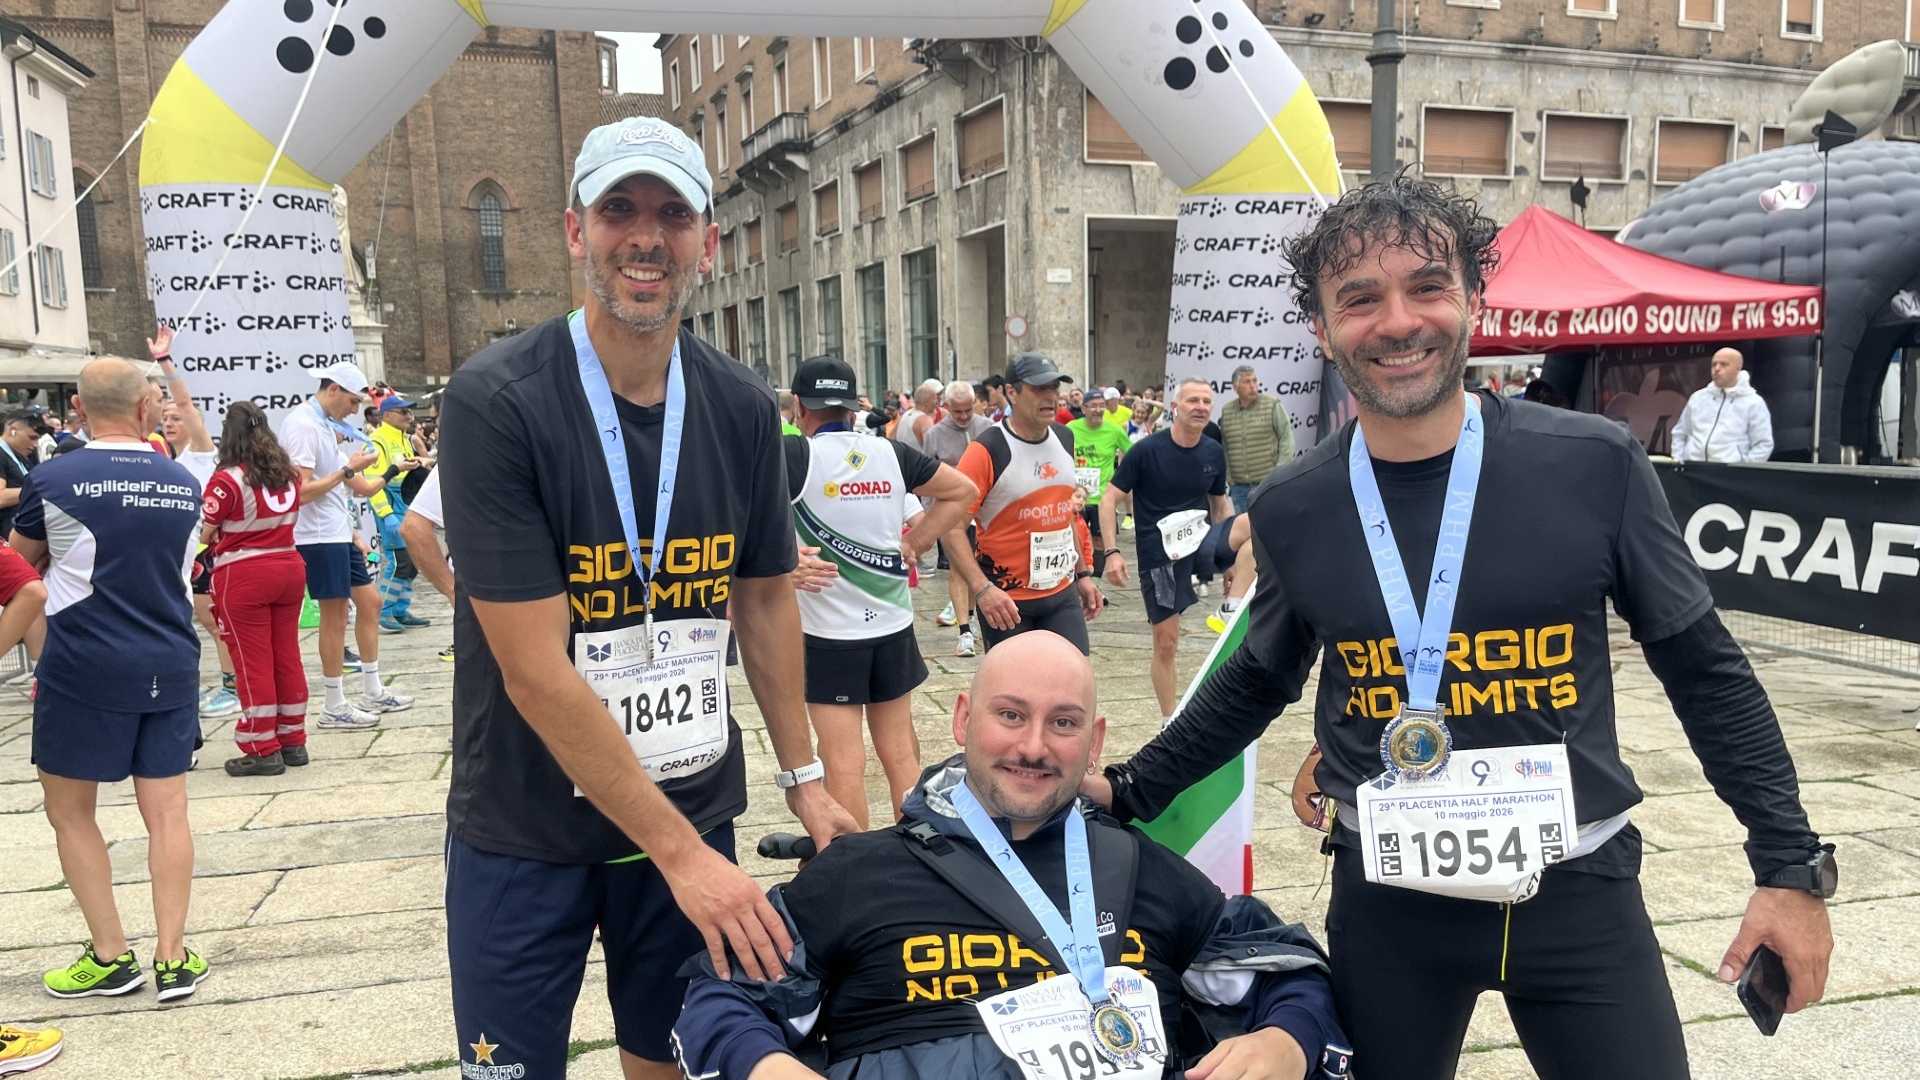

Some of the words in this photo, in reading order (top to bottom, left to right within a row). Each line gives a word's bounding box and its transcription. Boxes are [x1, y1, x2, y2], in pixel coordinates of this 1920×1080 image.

[158, 192, 235, 209] CRAFT
[273, 194, 330, 213] CRAFT
[1235, 200, 1307, 214] CRAFT
[224, 233, 308, 249] CRAFT
[1194, 237, 1260, 251] CRAFT
[170, 275, 248, 291] CRAFT
[286, 275, 343, 291] CRAFT
[237, 315, 320, 330] CRAFT
[1188, 309, 1253, 323] CRAFT
[1509, 309, 1560, 337] 94.6
[1568, 304, 1638, 335] RADIO
[1645, 304, 1722, 334] SOUND
[1731, 301, 1766, 331] FM
[1771, 297, 1819, 328] 95.0
[1223, 345, 1293, 360] CRAFT
[183, 356, 261, 372] CRAFT
[1276, 381, 1320, 395] CRAFT
[840, 481, 892, 496] CONAD
[122, 495, 195, 511] Piacenza
[1018, 503, 1054, 520] SPORT
[1177, 525, 1193, 541] 816
[1684, 502, 1920, 594] CRAF
[570, 590, 616, 623] NO
[623, 575, 731, 616] LMITS
[650, 661, 669, 672] HALF
[671, 653, 714, 667] MARATHON
[669, 668, 686, 677] 2026
[1345, 686, 1401, 720] NO
[1443, 672, 1578, 717] IMITS
[620, 684, 693, 735] 1842
[660, 752, 709, 773] CRAFT
[1534, 760, 1553, 773] PHM
[1399, 800, 1459, 811] PLACENTIA
[1461, 797, 1489, 807] HALF
[1492, 793, 1555, 805] MARATHON
[1435, 811, 1446, 820] 10
[1448, 809, 1487, 821] maggio
[1489, 807, 1514, 817] 2026
[1411, 827, 1527, 878] 1954
[906, 974, 979, 1001] NO
[1127, 979, 1143, 993] PHM
